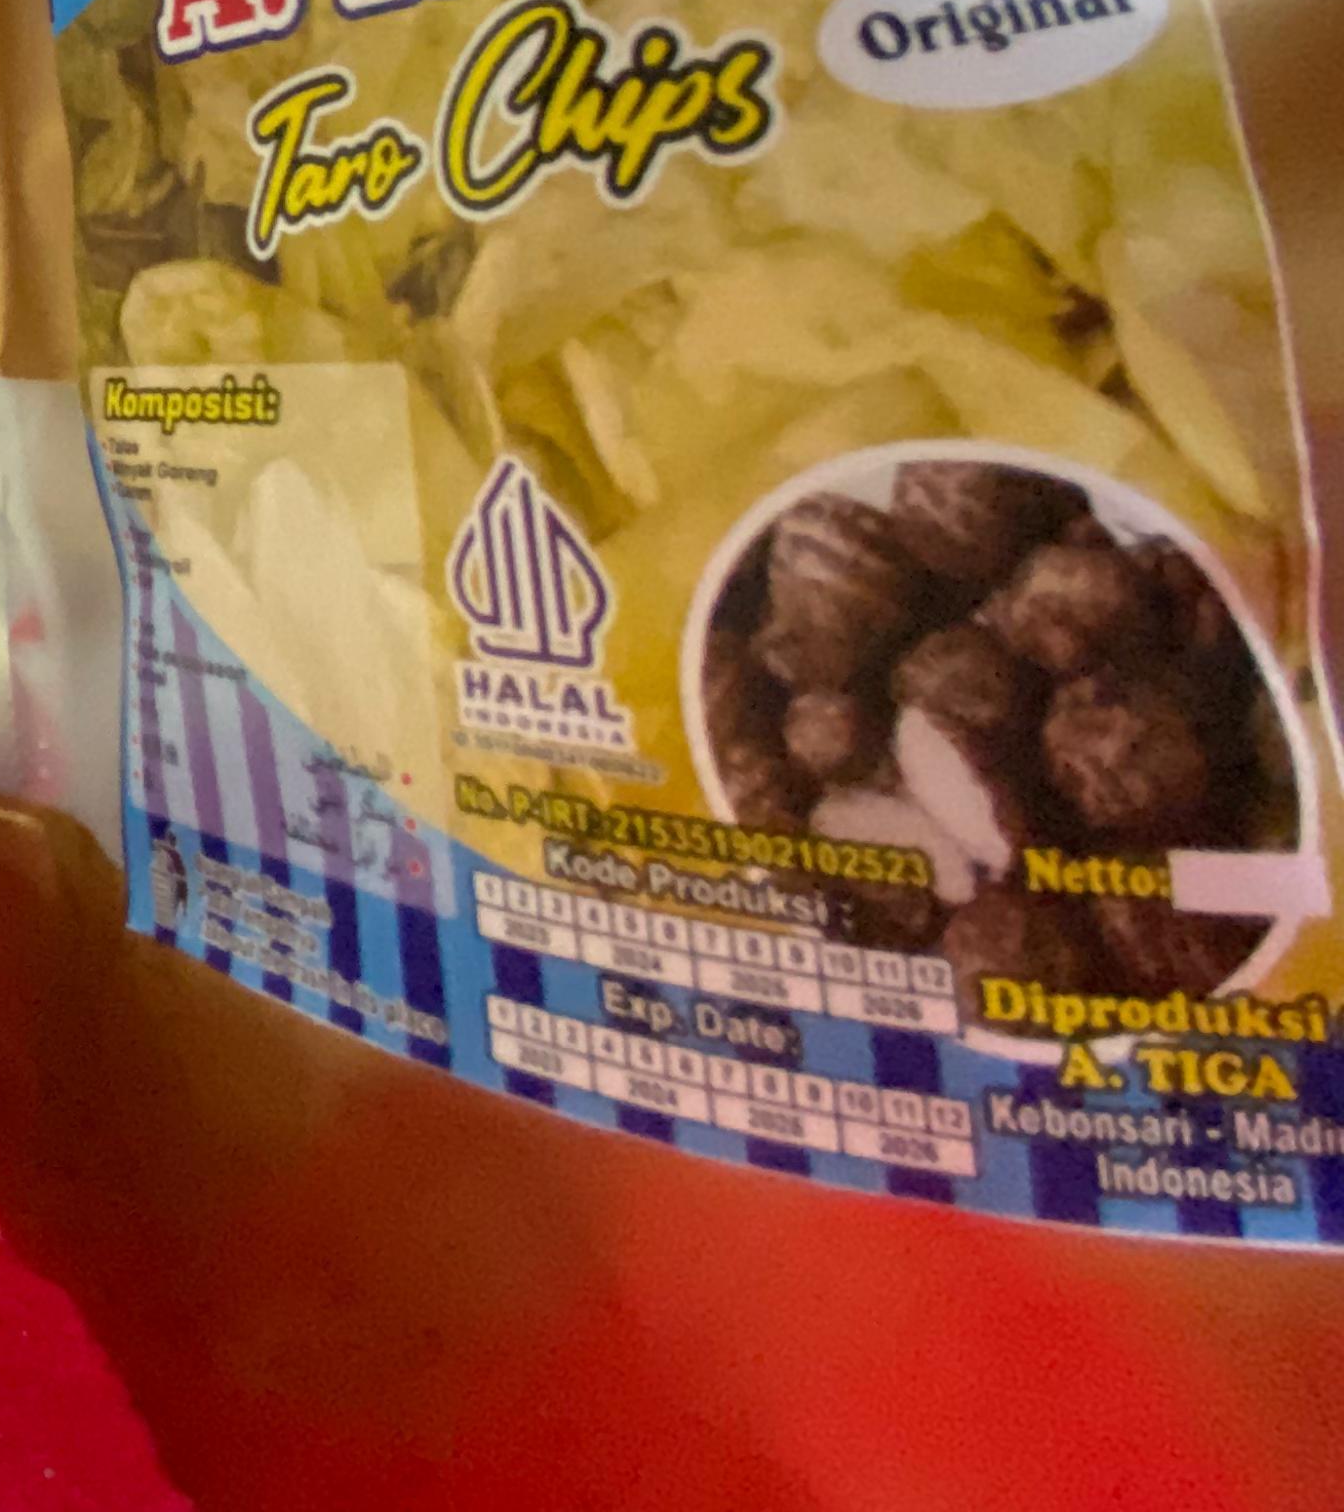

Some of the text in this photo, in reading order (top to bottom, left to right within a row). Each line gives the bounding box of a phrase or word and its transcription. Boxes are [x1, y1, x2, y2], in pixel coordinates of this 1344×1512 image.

[251, 0, 771, 247] Taro Chips
[105, 374, 280, 435] Komposisi:
[464, 669, 625, 723] HALAL
[547, 841, 637, 888] Kode
[648, 862, 829, 926] Produksi
[981, 979, 1328, 1043] Diproduksi
[1061, 1044, 1298, 1100] A. TIGA
[989, 1092, 1193, 1145] Kebonsari
[1096, 1154, 1296, 1205] Indonesia
